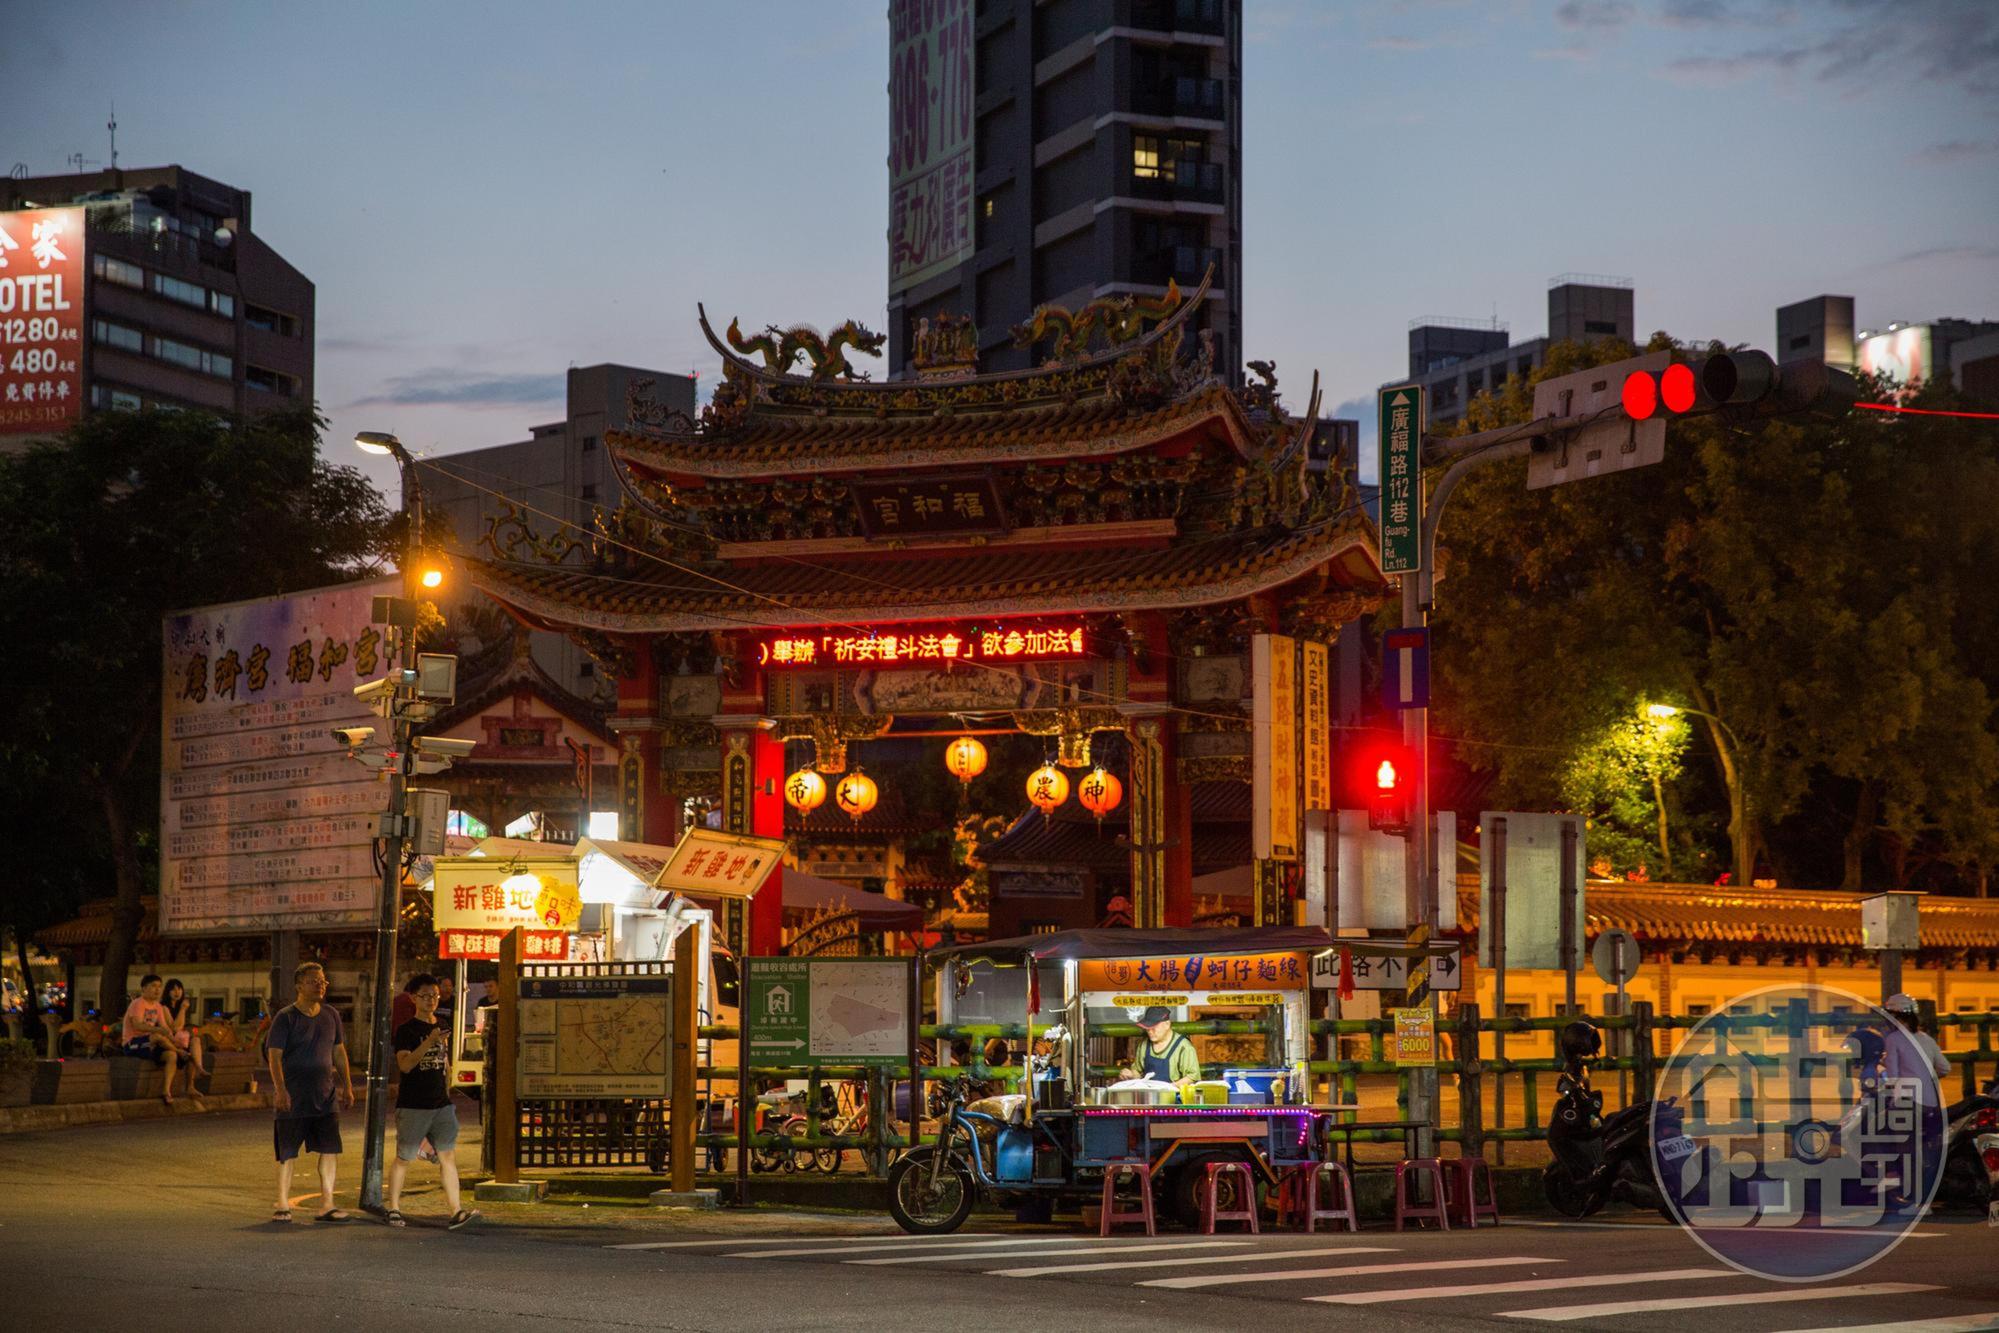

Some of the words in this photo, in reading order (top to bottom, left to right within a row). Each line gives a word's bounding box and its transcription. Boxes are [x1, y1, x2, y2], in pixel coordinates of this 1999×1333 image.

[5, 380, 70, 402] 免費停車
[1385, 525, 1410, 537] Guang-
[789, 777, 808, 804] 帝
[840, 783, 859, 805] 大
[1034, 776, 1055, 801] 農
[1085, 780, 1104, 805] 神
[453, 884, 533, 911] 新雞地
[526, 935, 562, 955] 雞排
[1137, 959, 1180, 982] 大腸
[1207, 957, 1302, 981] 蚵仔麵線
[1315, 953, 1431, 978] 此路不
[1402, 1038, 1430, 1052] 6000
